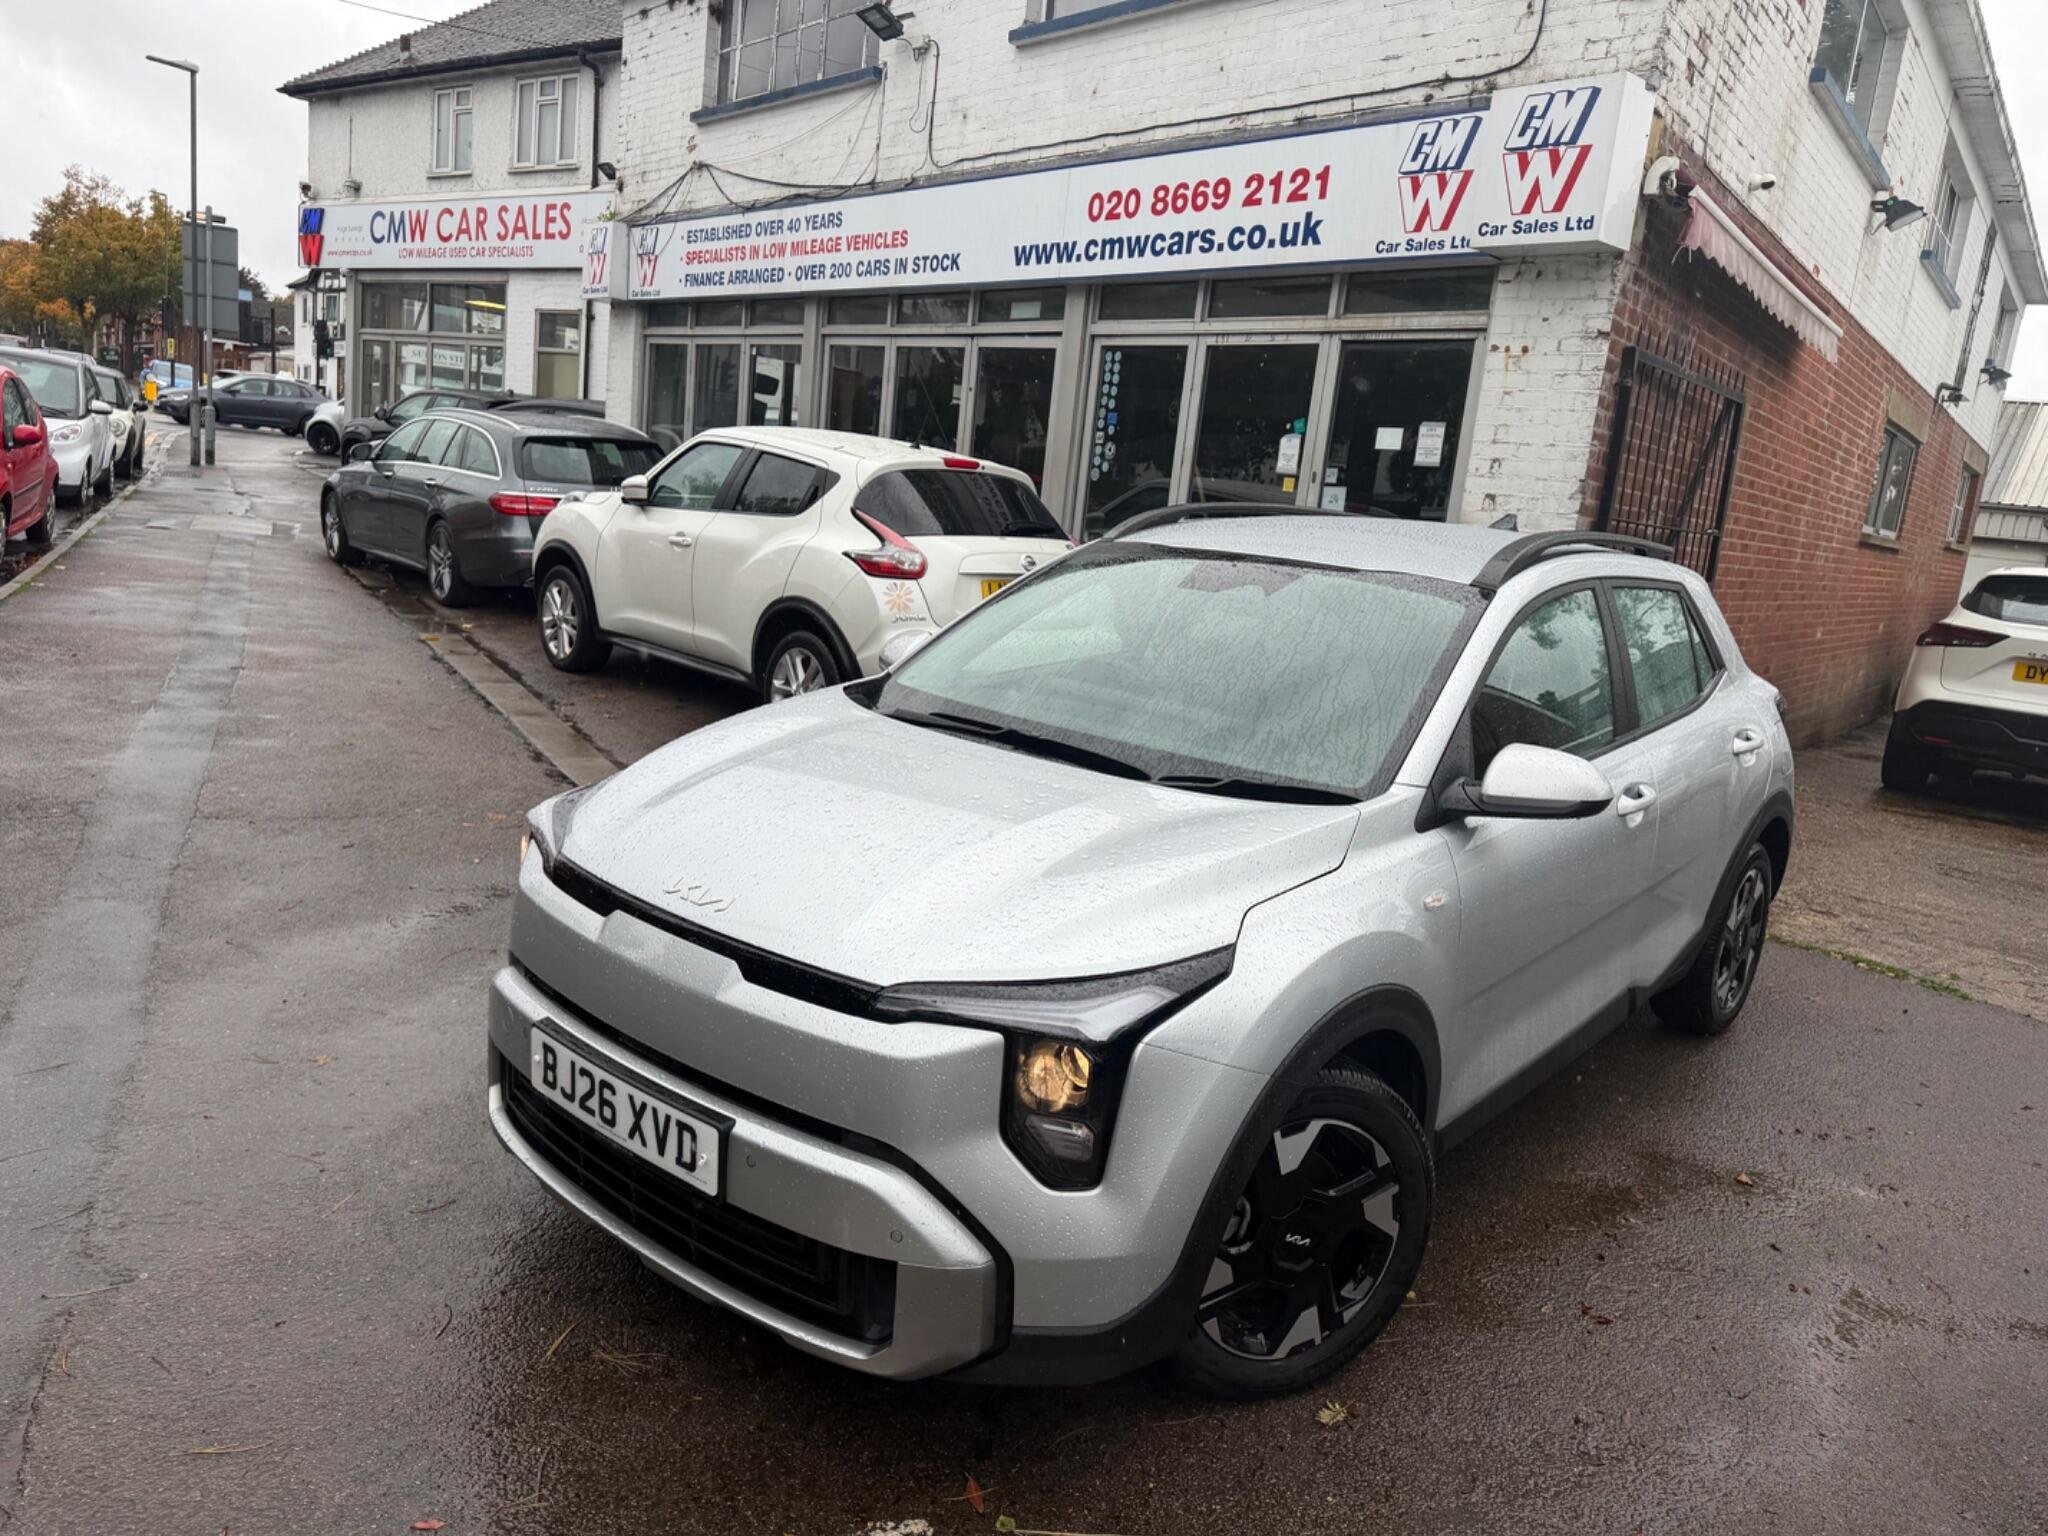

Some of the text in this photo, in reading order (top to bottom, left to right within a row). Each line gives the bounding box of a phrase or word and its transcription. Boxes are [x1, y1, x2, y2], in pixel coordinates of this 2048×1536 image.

[1088, 165, 1331, 223] 020 8669 2121
[370, 202, 572, 244] CMW CAR SALES
[686, 211, 843, 244] ESTABLISHED OVER 40 YEARS
[1013, 211, 1324, 267] www.cmwcars.co.uk
[1478, 215, 1595, 237] Car Sales Ltd
[398, 245, 534, 259] LOW MILEAGE USED CAR SPECIALISTS
[685, 229, 909, 265] SPECIALISTS IN LOW MILEAGE VEHICLES
[1375, 239, 1401, 253] Car
[1405, 237, 1446, 252] Sales
[684, 252, 962, 287] FINANCE ARRANGED OVER 200 CARS IN STOCK
[541, 1042, 698, 1173] BJ26 XVD
